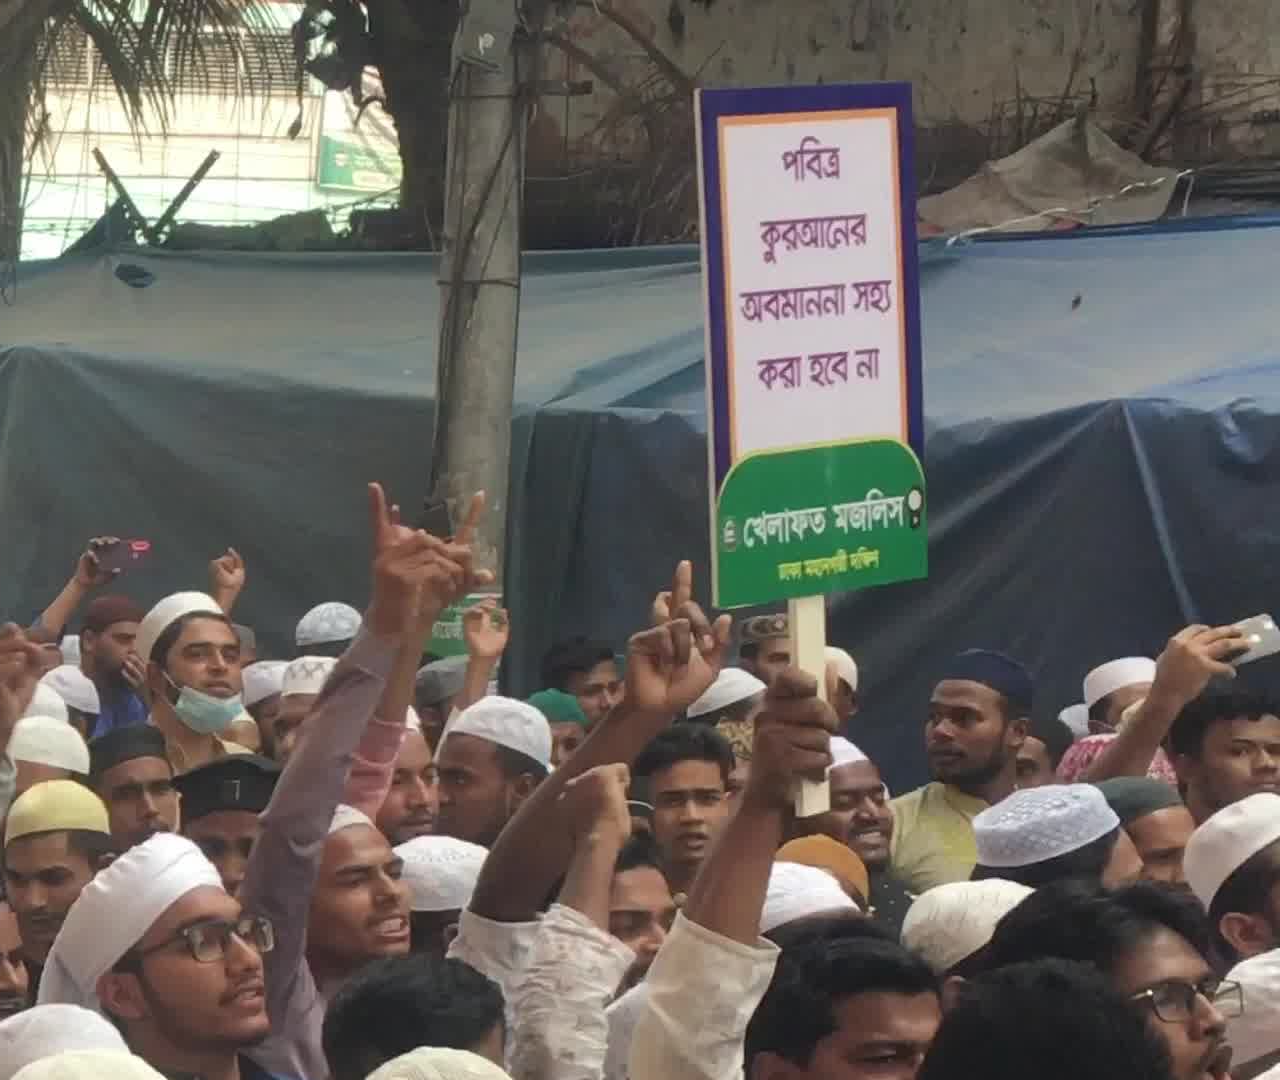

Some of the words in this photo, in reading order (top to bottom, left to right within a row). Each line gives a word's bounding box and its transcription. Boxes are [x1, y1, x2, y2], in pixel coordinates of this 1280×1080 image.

[781, 136, 841, 182] পবিত্র
[760, 214, 867, 263] কুরআনের
[740, 283, 846, 323] অবমাননা
[852, 279, 892, 313] সহ্য
[757, 356, 802, 391] করা
[808, 351, 849, 387] হবে
[854, 348, 881, 380] না
[743, 507, 827, 548] খেলাফত
[831, 488, 906, 535] মজলিস
